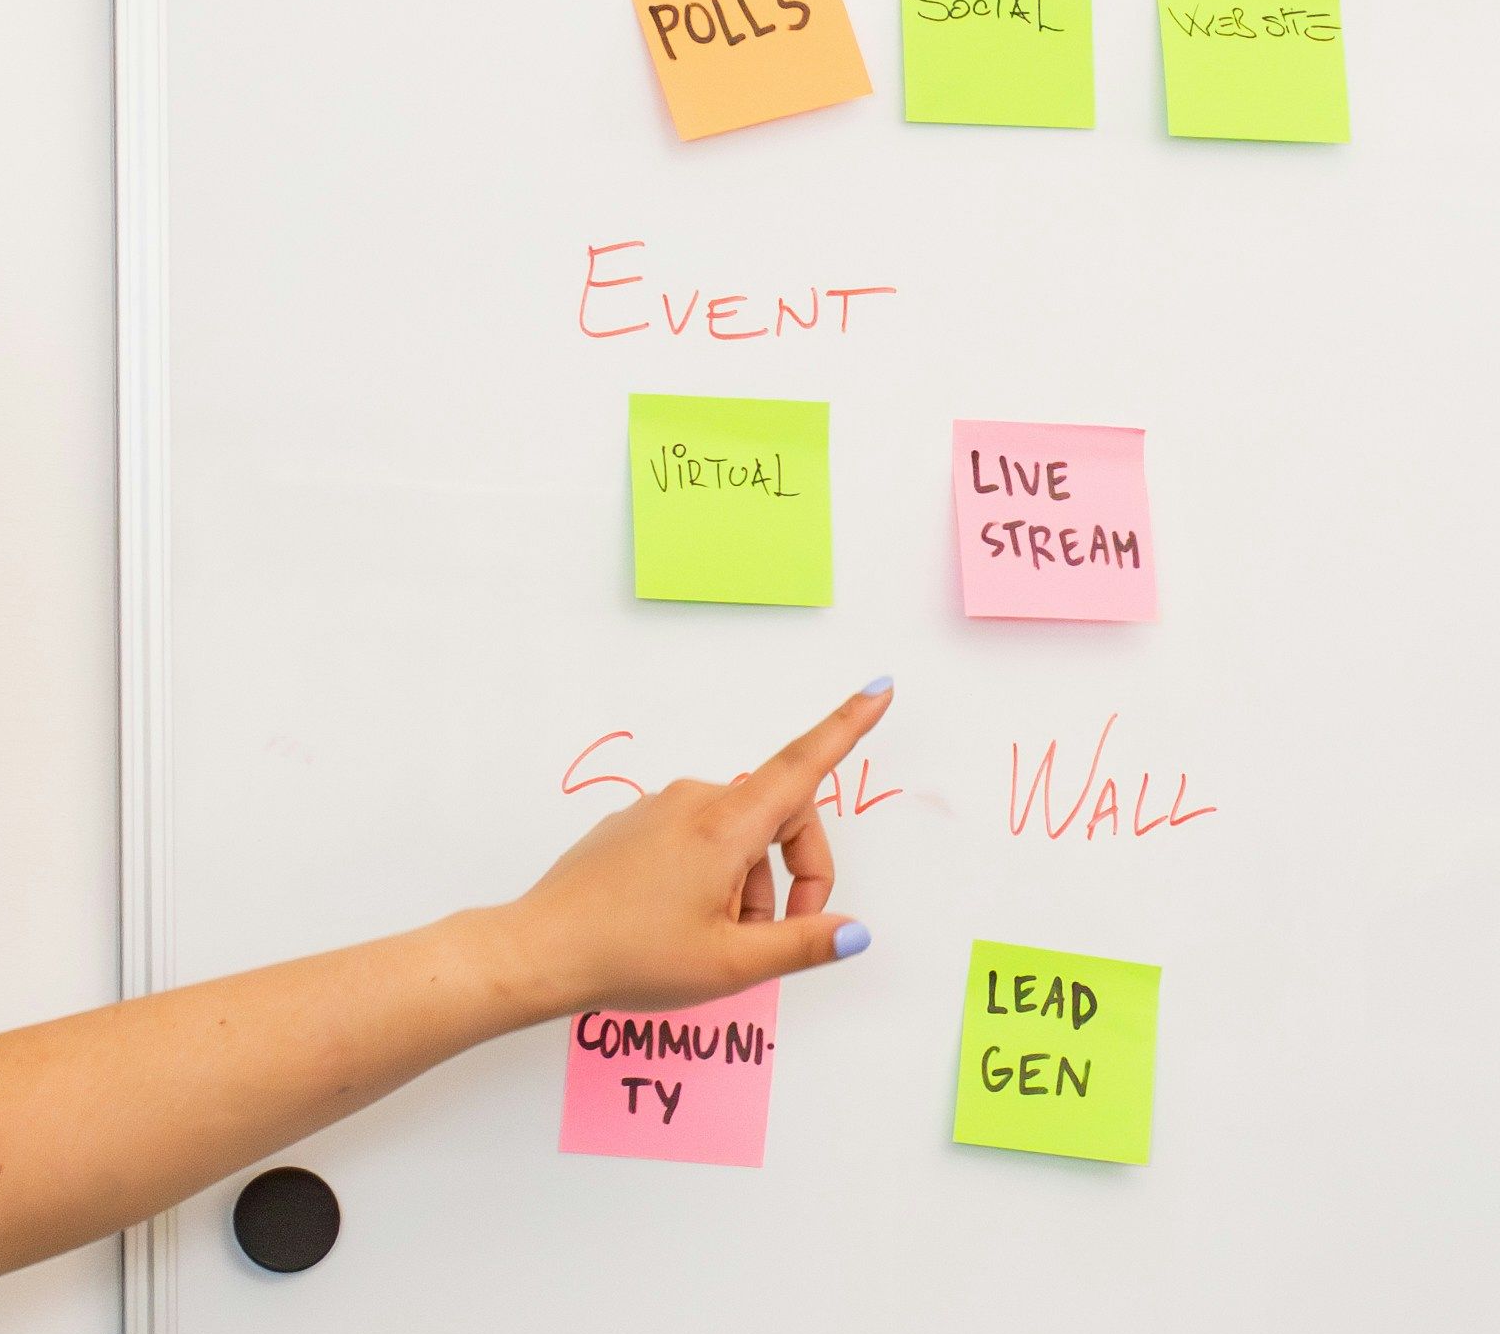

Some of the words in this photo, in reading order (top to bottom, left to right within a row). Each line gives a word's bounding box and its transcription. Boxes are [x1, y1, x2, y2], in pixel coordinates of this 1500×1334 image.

[580, 241, 897, 342] EVENT
[972, 451, 1071, 502] LIVE
[982, 521, 1141, 570] STREAM
[1010, 713, 1217, 841] WALL
[988, 971, 1098, 1031] LEAD
[983, 1047, 1092, 1098] GEN
[622, 1078, 683, 1125] TY
